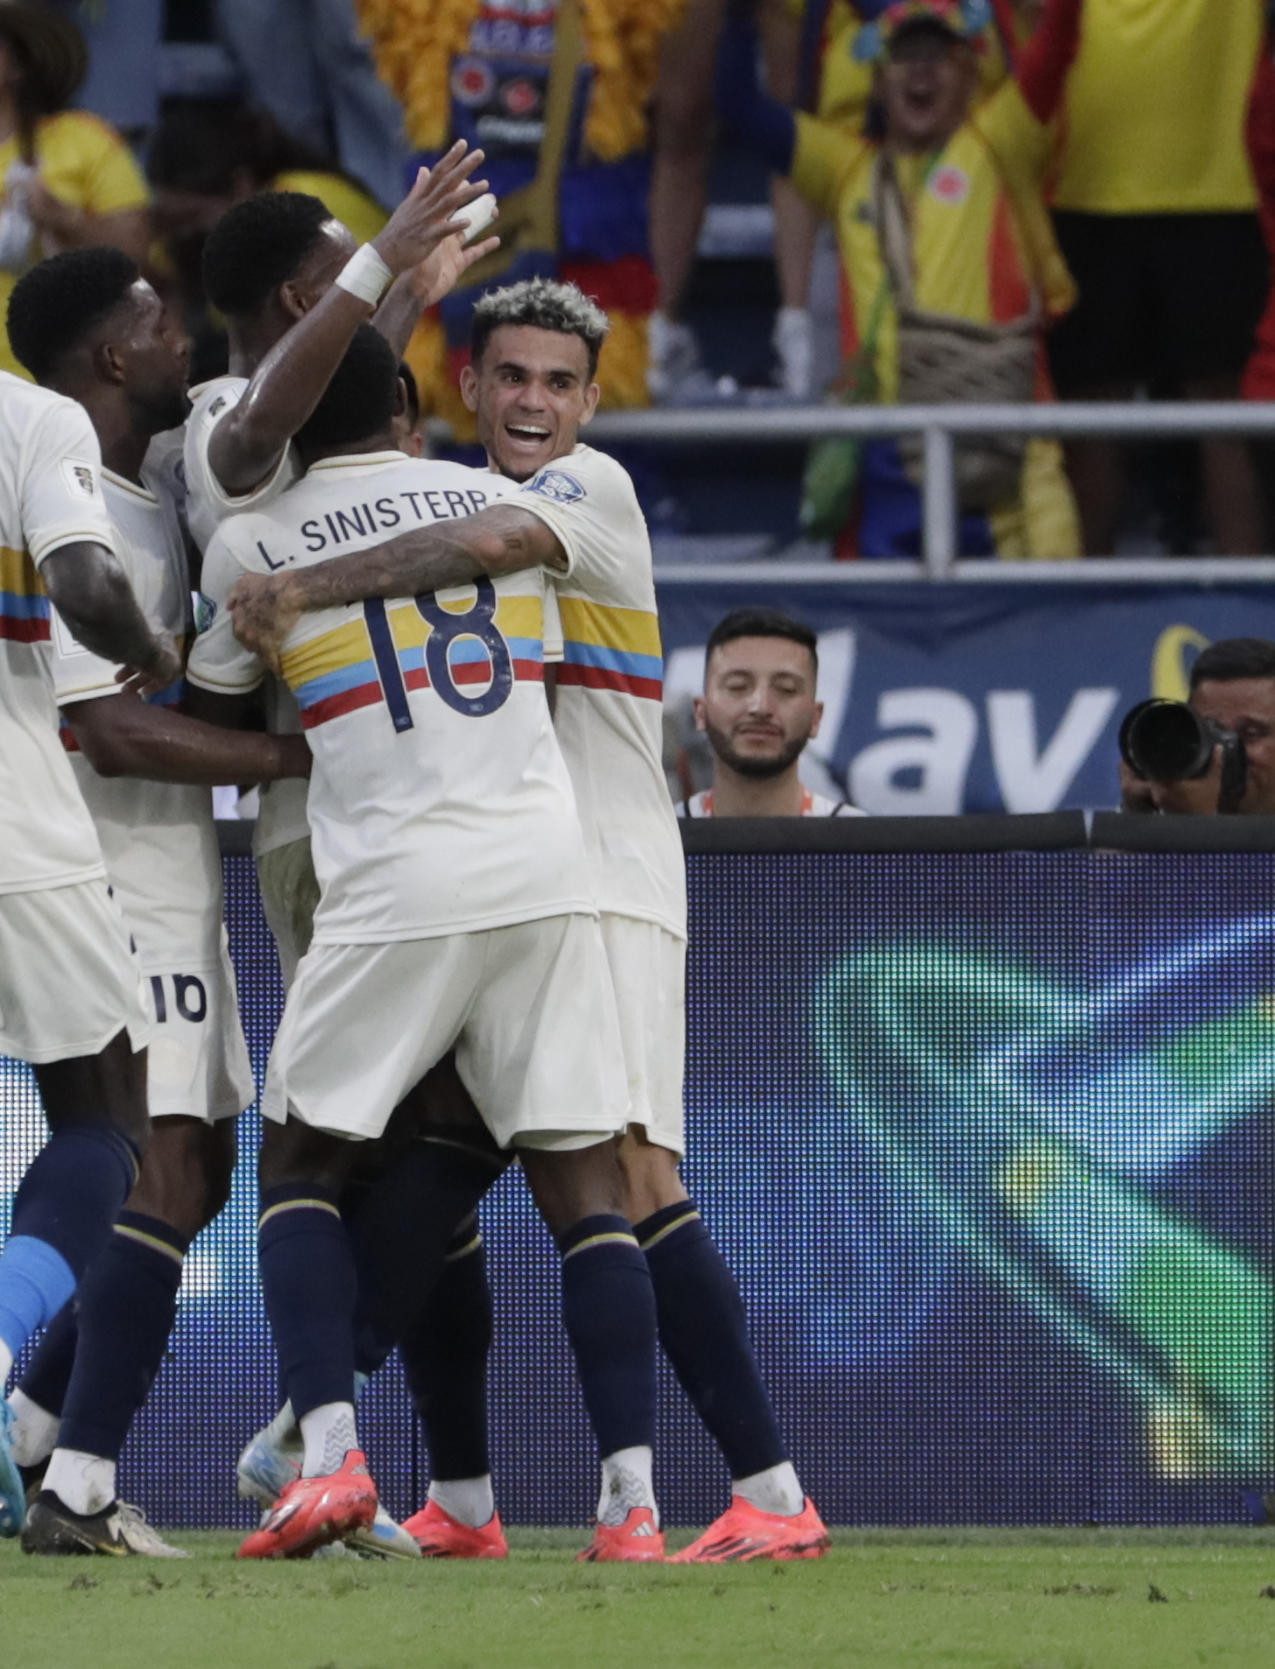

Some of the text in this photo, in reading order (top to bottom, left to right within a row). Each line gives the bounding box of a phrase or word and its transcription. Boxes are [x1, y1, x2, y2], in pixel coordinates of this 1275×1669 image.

[257, 489, 503, 570] L. SINISTERR
[348, 574, 514, 734] 18
